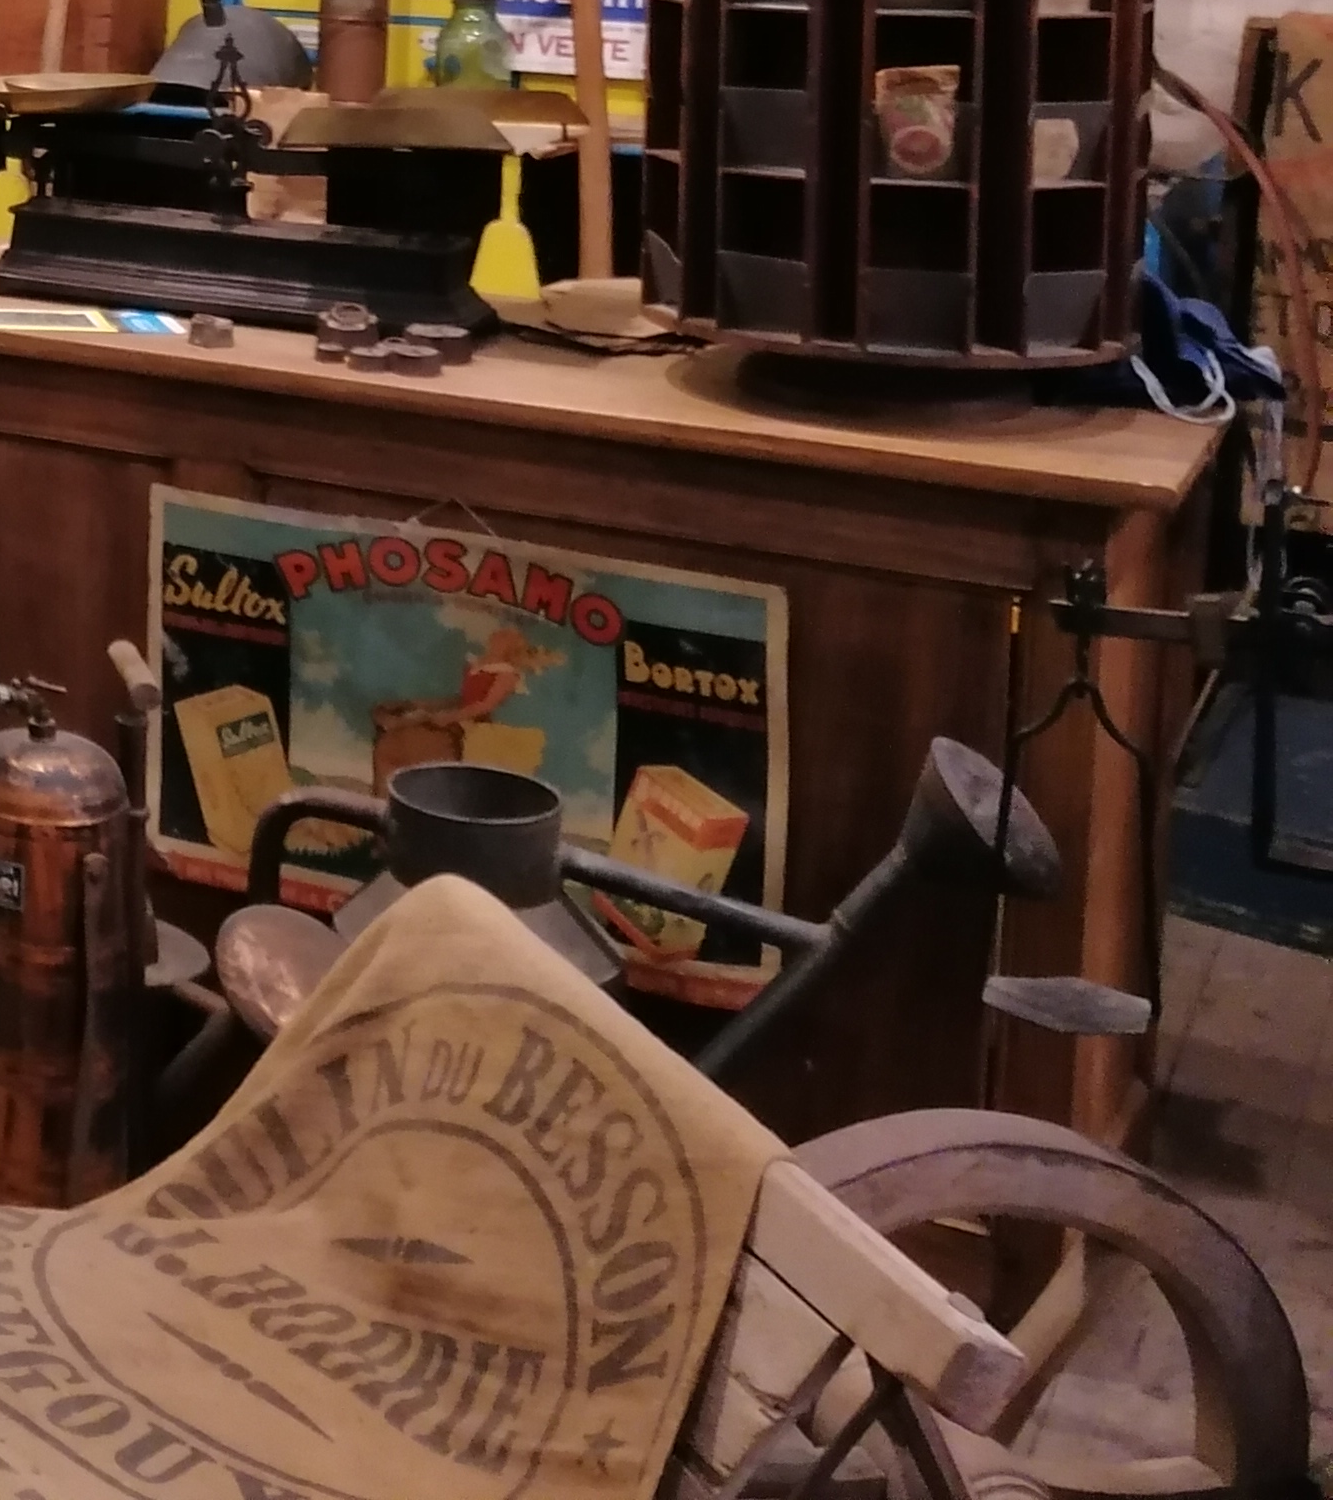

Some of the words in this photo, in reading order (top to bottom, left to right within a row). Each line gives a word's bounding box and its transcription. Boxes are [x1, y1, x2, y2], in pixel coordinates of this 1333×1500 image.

[276, 537, 624, 646] PHOSAMO
[145, 1019, 417, 1220] OULIN
[421, 1040, 483, 1105] DU
[483, 1026, 681, 1394] BESSON
